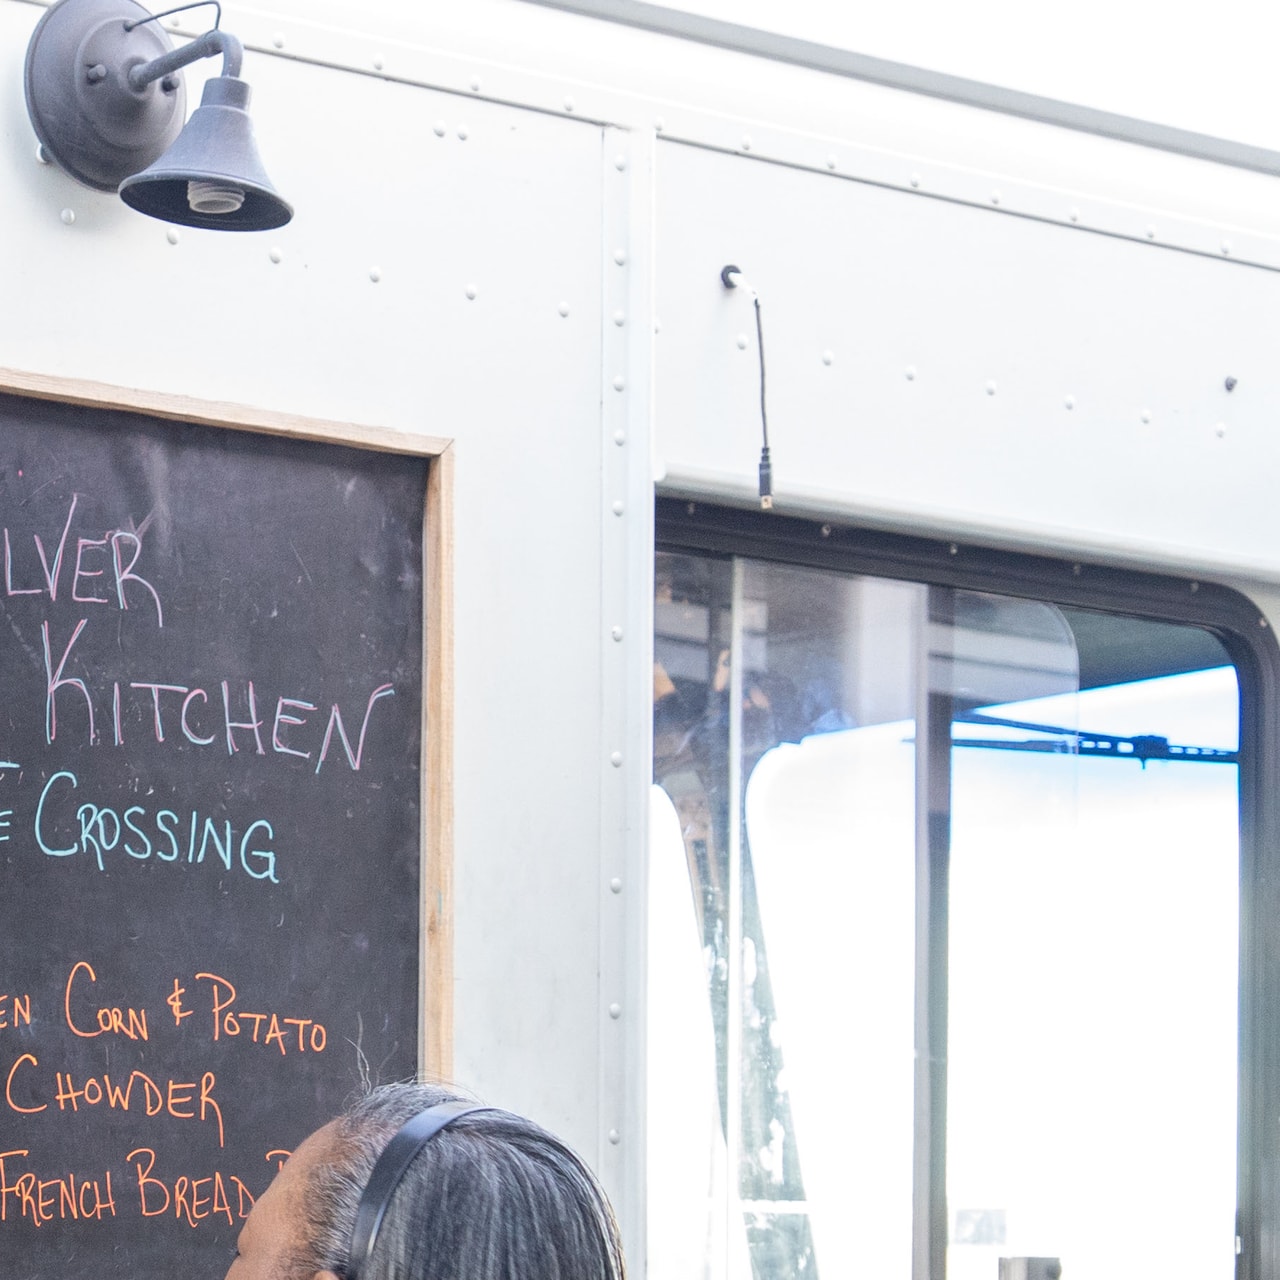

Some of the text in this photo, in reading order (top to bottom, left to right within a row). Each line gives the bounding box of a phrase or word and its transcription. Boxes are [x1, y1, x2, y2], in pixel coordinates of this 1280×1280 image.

[41, 618, 396, 774] KITCHEN
[35, 771, 280, 884] CROSSING
[65, 960, 148, 1042] CORN
[195, 971, 327, 1056] POTATO
[6, 1053, 225, 1148] CHOWDER
[126, 1147, 256, 1228] BREAD
